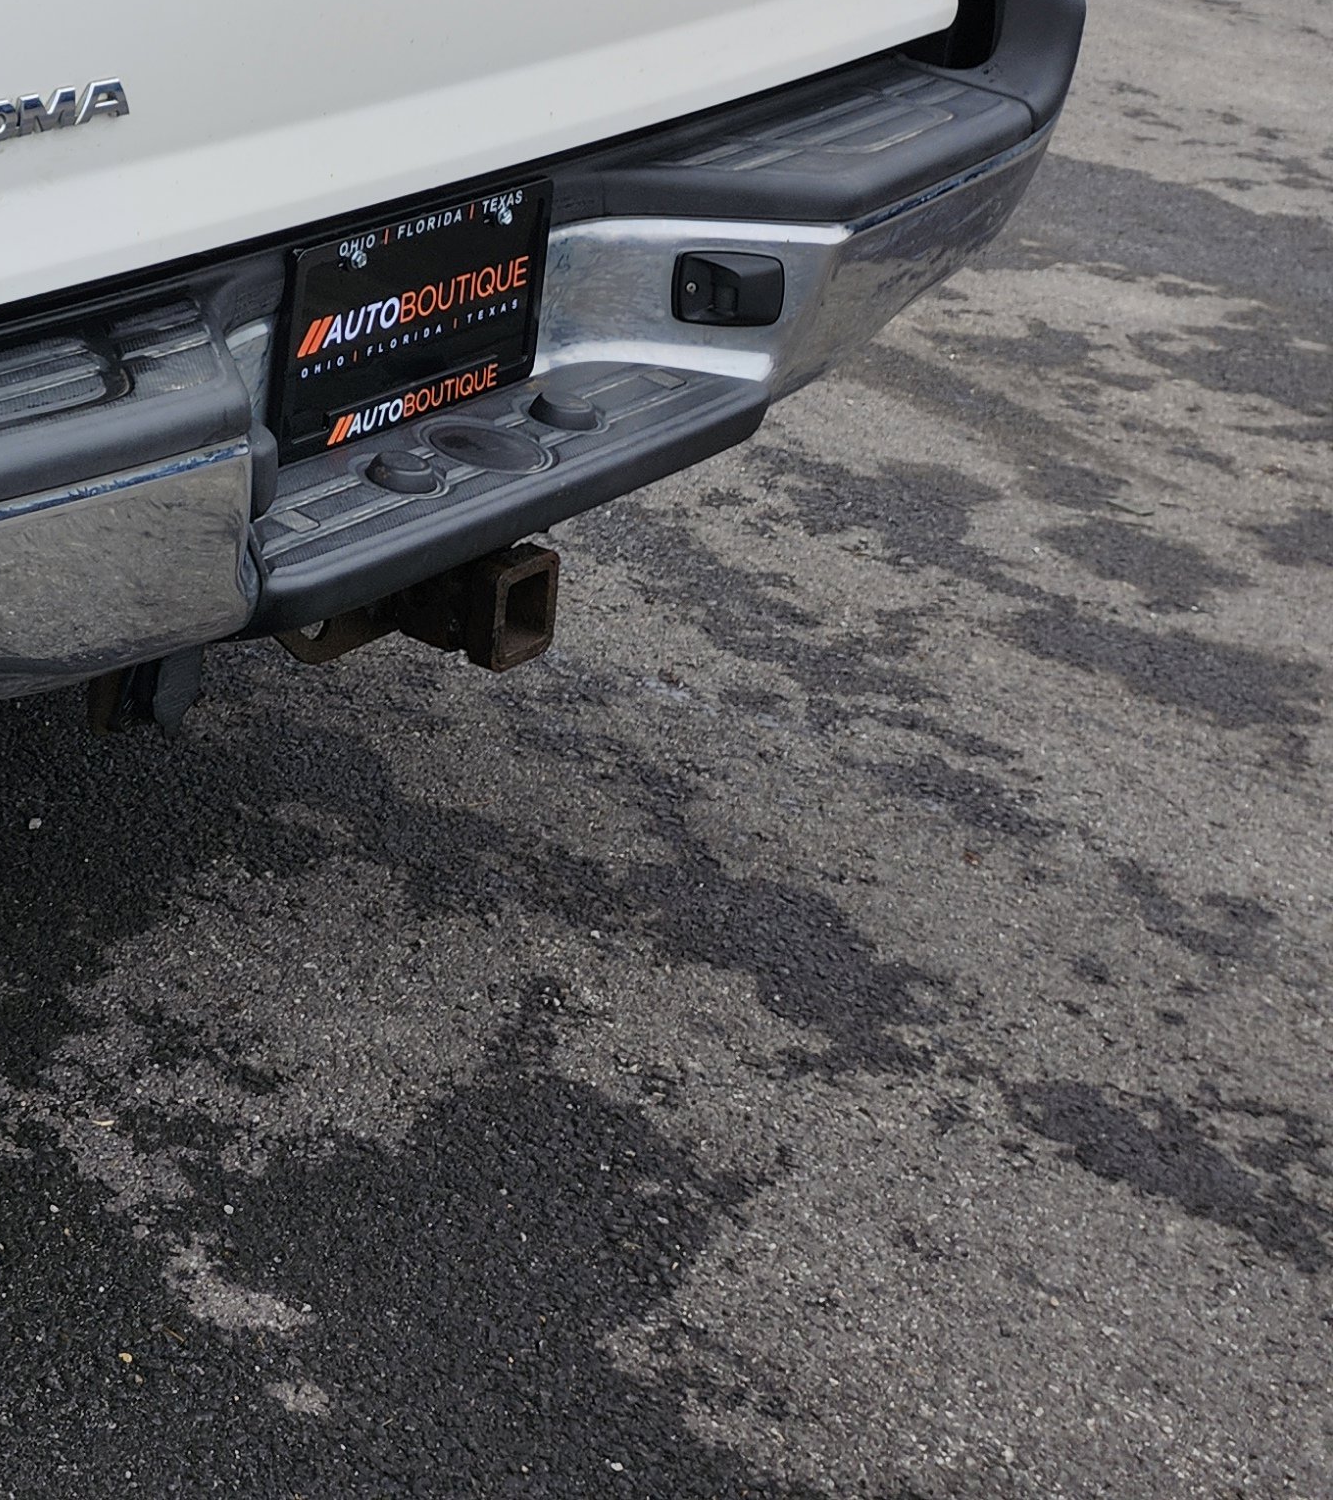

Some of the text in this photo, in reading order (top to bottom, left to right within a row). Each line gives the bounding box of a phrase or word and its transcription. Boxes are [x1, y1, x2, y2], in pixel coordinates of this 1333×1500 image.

[339, 189, 523, 257] OHIO FLORIDA TEXAS
[301, 298, 519, 379] OHIO FLORIDA TEXAS
[322, 255, 529, 348] AUTOBOUTIQUE
[347, 362, 499, 438] AUTOBOUTIQUE
